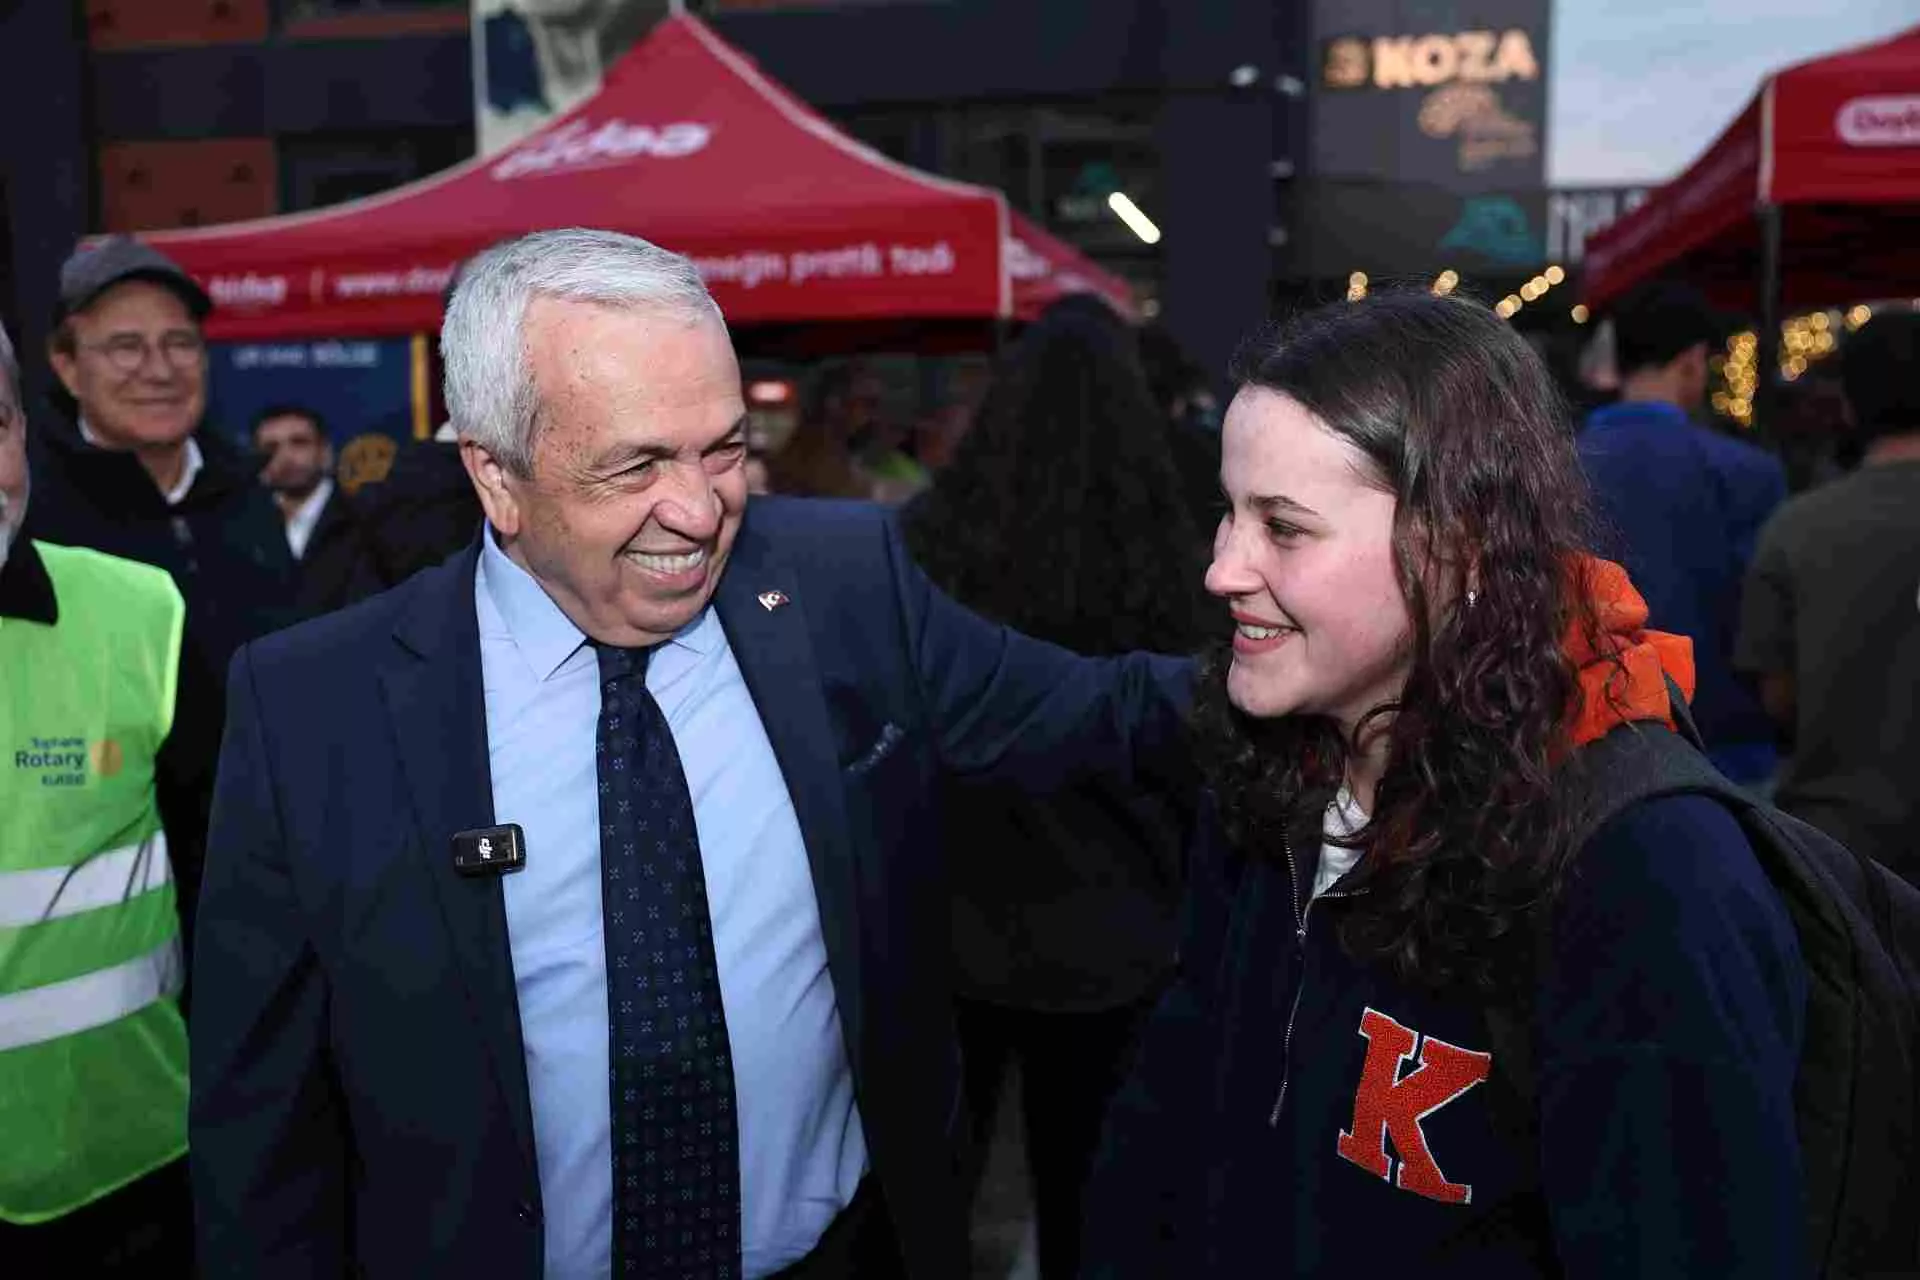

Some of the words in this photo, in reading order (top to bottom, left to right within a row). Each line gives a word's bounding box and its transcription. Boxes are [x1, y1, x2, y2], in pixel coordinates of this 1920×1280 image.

[1372, 28, 1540, 90] KOZA
[15, 750, 85, 771] Rotary
[1337, 1006, 1493, 1205] K
